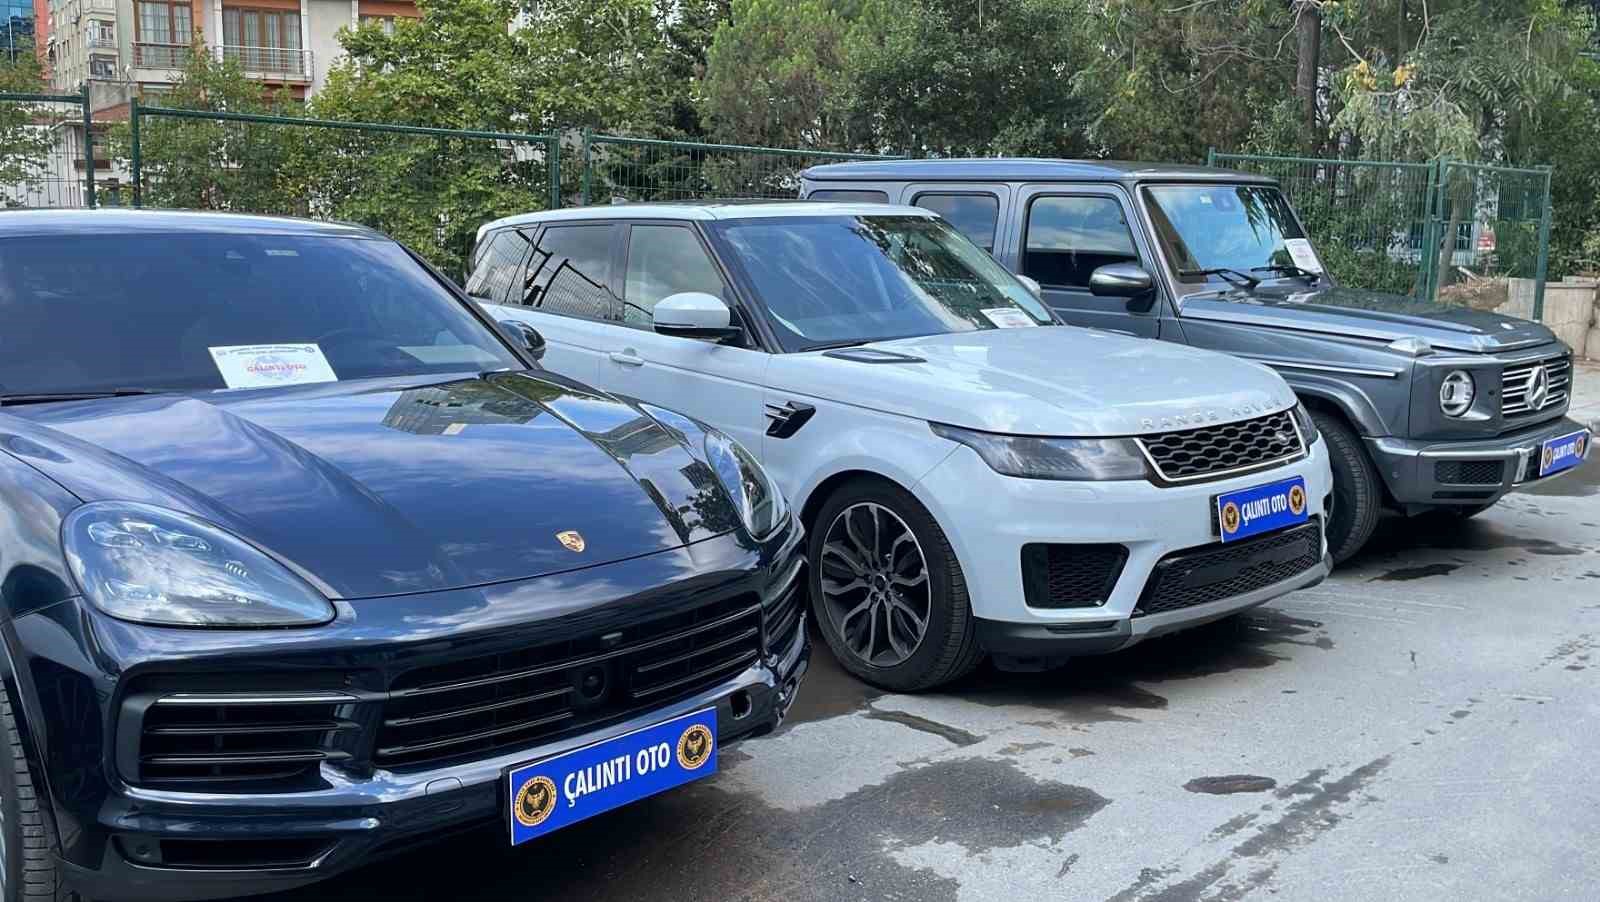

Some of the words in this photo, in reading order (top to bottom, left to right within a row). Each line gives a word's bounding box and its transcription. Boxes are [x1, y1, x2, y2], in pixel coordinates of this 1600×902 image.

[1140, 410, 1219, 430] RANGE
[1230, 399, 1283, 417] ROVER
[1241, 498, 1271, 527] ÇALINTI
[1271, 494, 1287, 513] OTO
[563, 754, 631, 808] ÇALINTI
[636, 742, 671, 776] OTO
